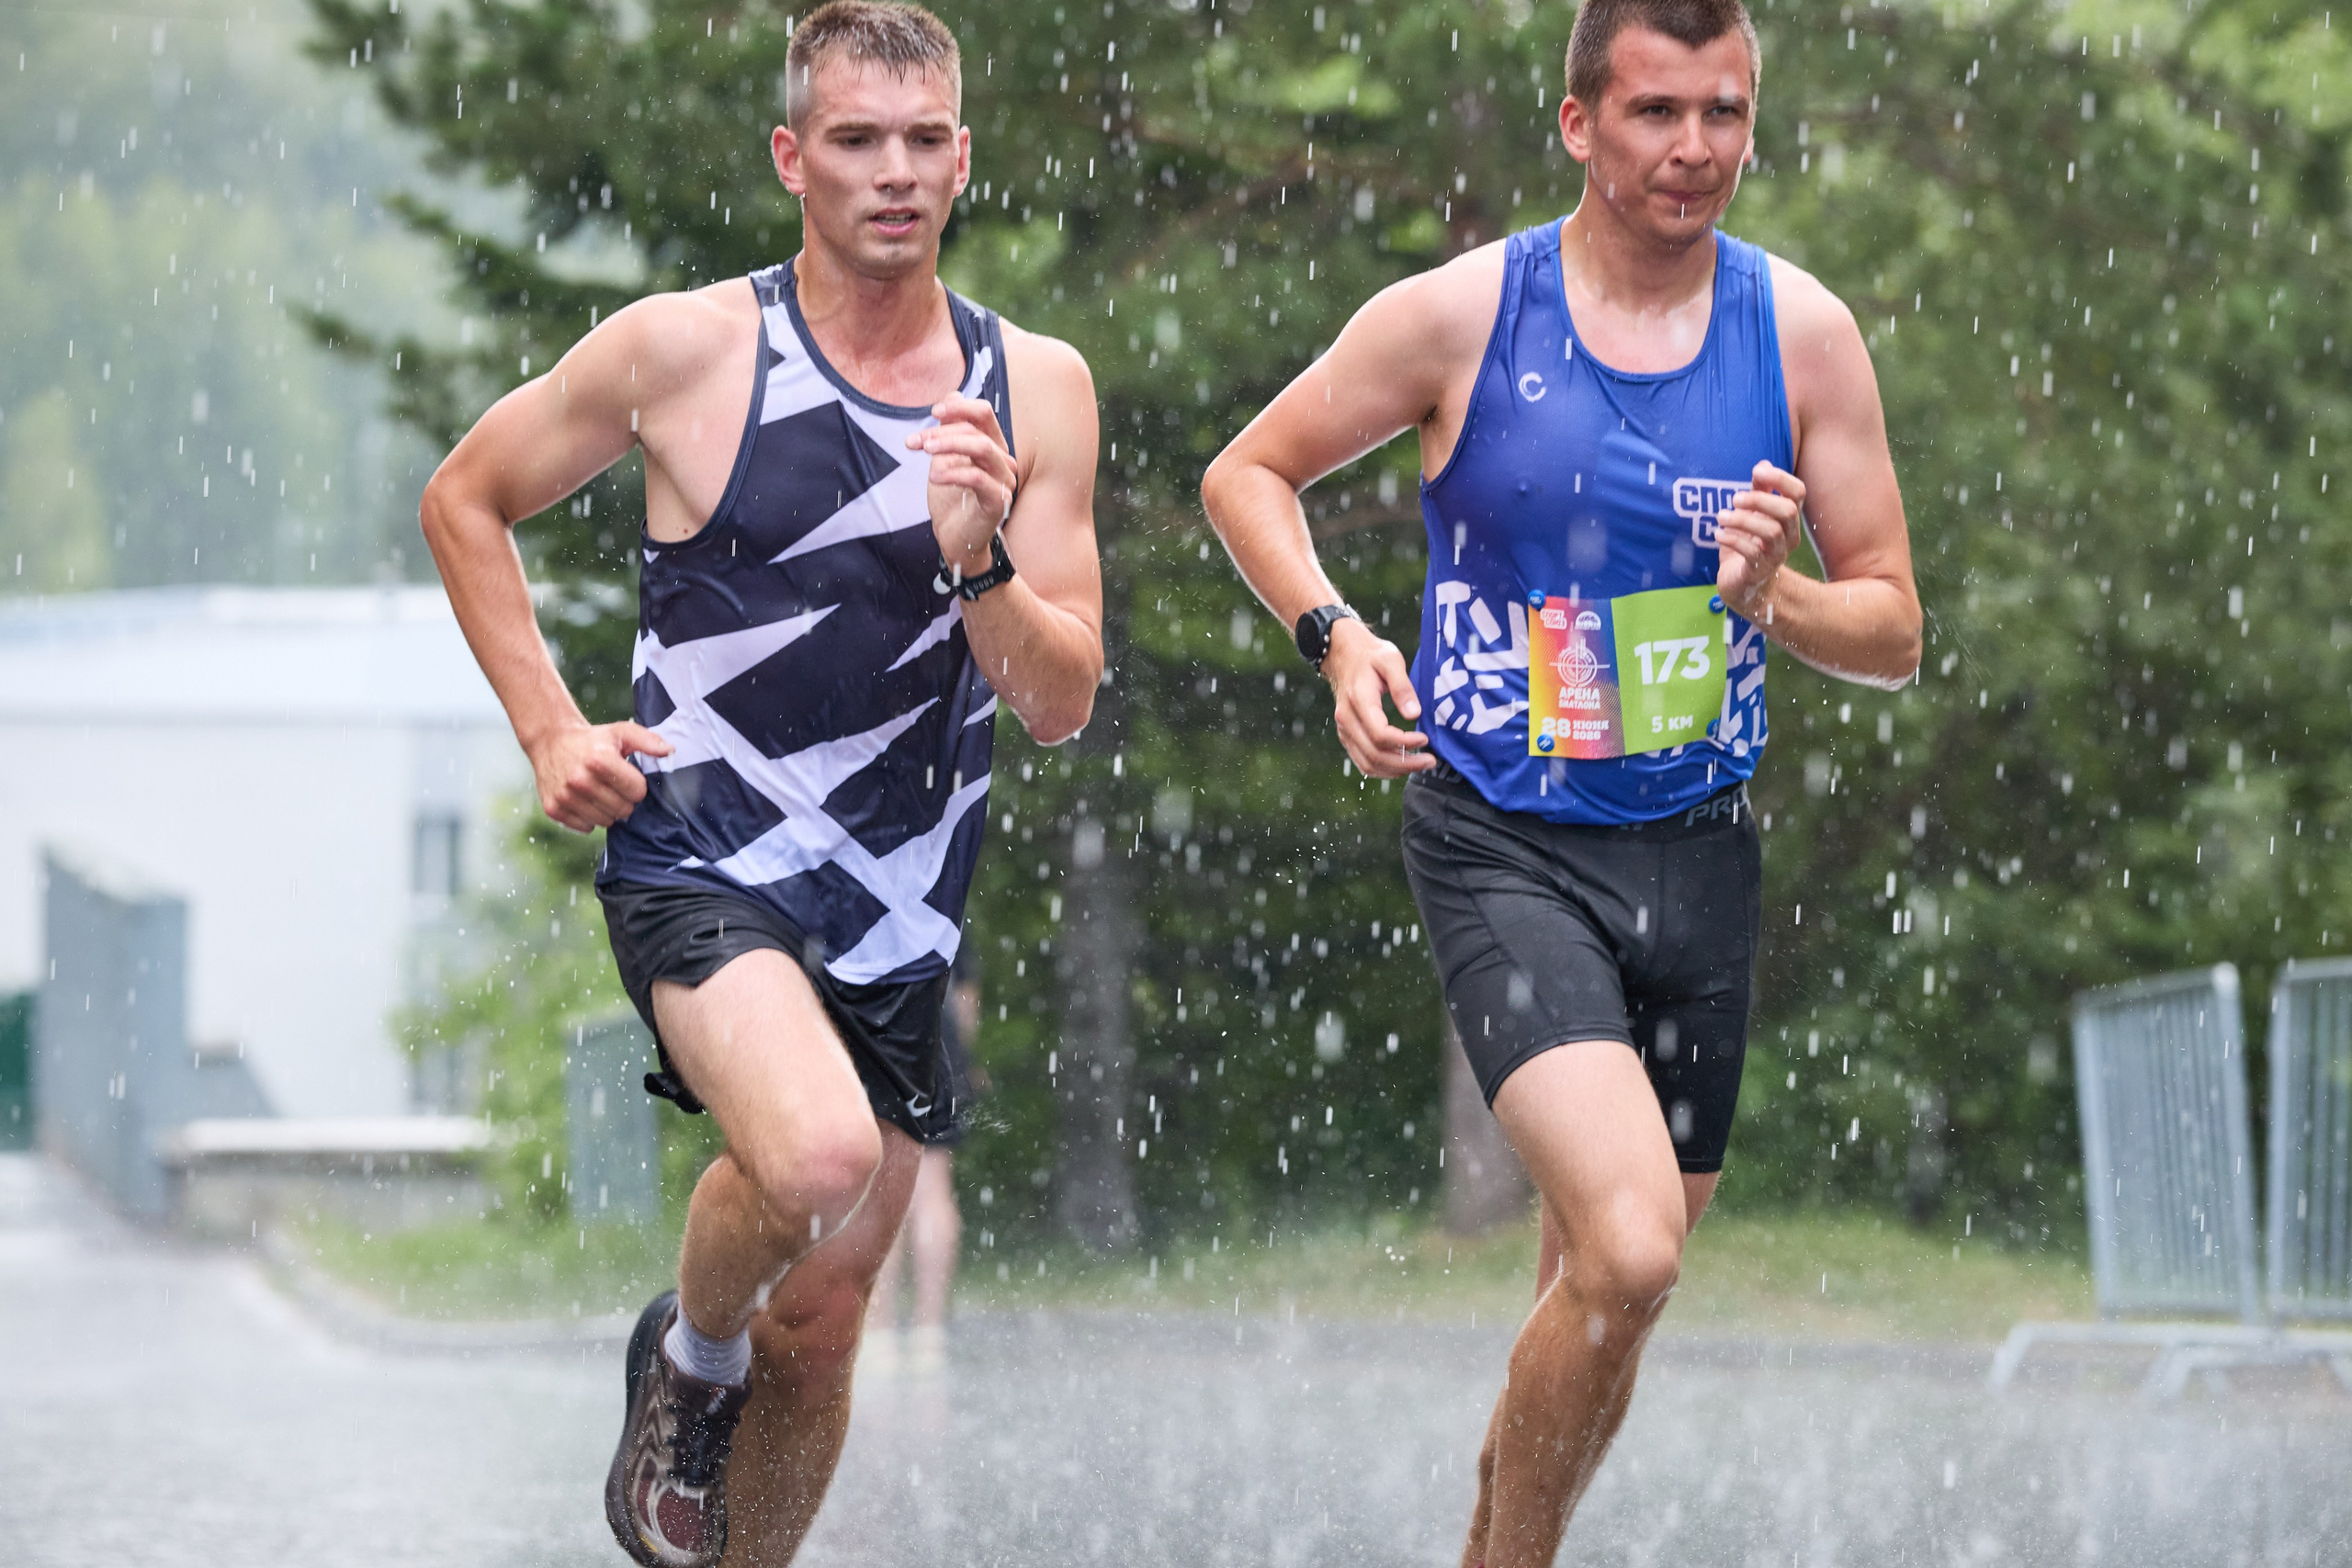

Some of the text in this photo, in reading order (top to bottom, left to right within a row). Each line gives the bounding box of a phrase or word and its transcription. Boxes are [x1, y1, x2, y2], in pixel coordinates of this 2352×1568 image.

[1679, 484, 1751, 514] СПО
[1634, 636, 1710, 685] 173
[1559, 686, 1600, 701] АРЕНА
[1542, 716, 1610, 739] 28 ИЮНЯ
[1651, 716, 1664, 734] 5
